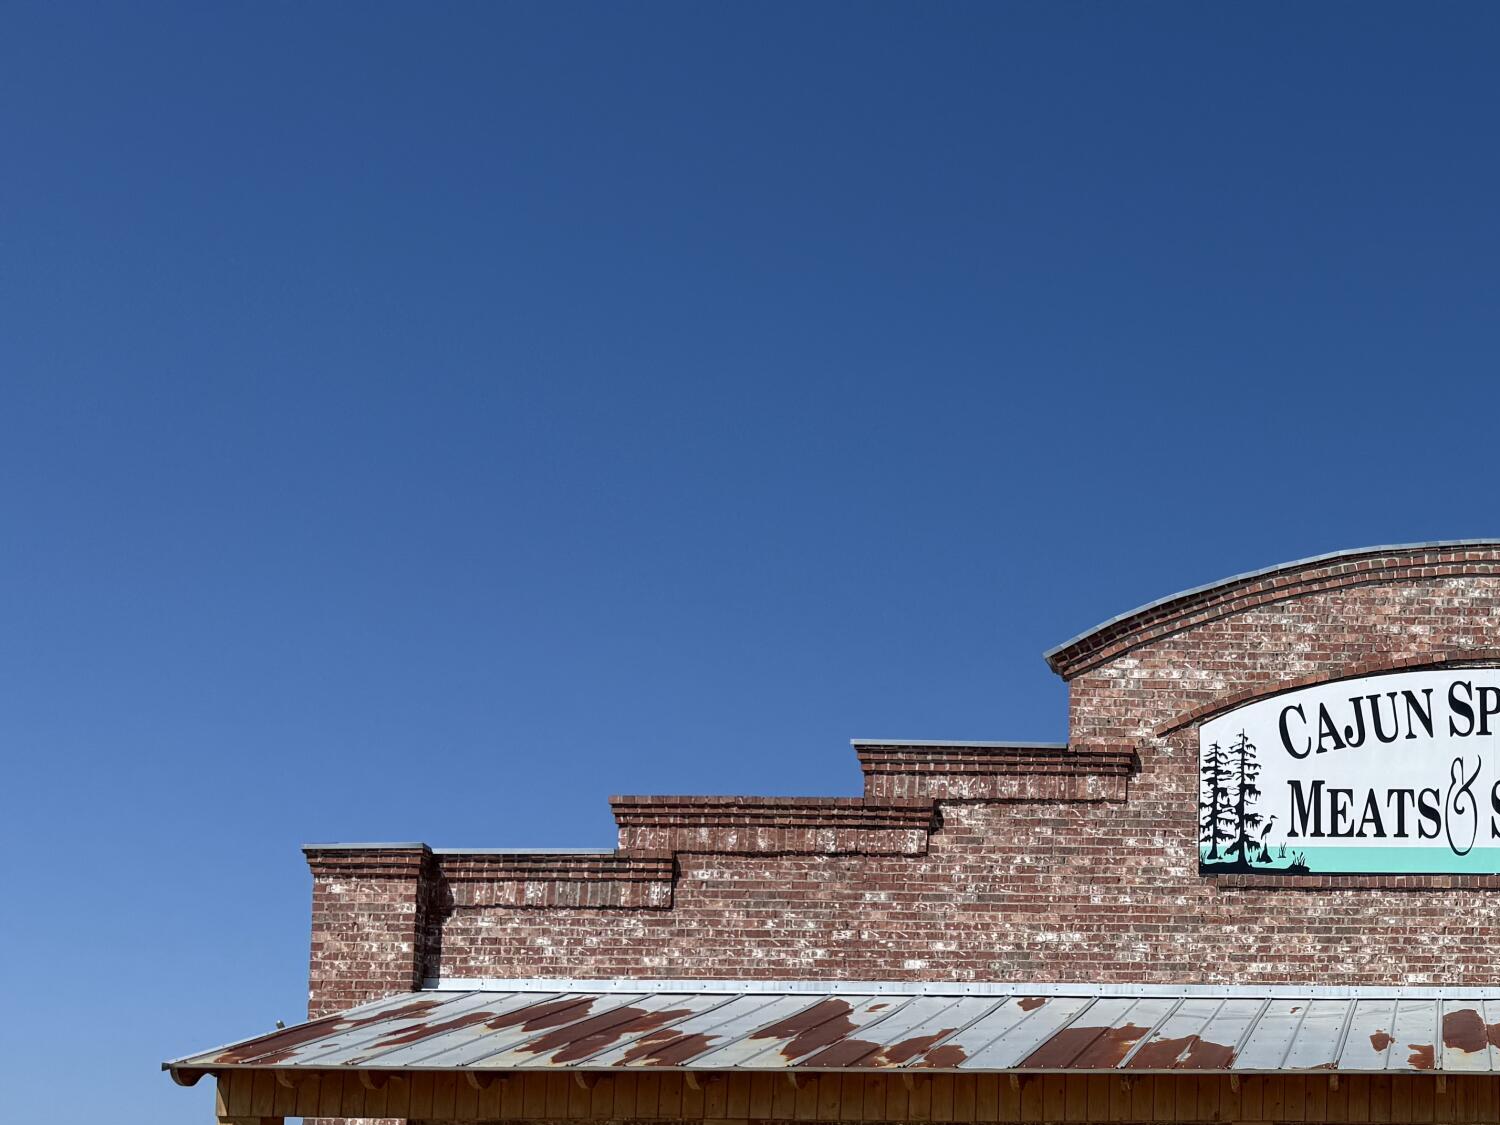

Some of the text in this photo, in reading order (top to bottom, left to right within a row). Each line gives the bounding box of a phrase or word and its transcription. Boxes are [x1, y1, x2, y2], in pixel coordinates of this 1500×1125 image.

[1278, 688, 1434, 760] CAJUN
[1286, 779, 1442, 839] MEATS
[1445, 754, 1482, 857] &
